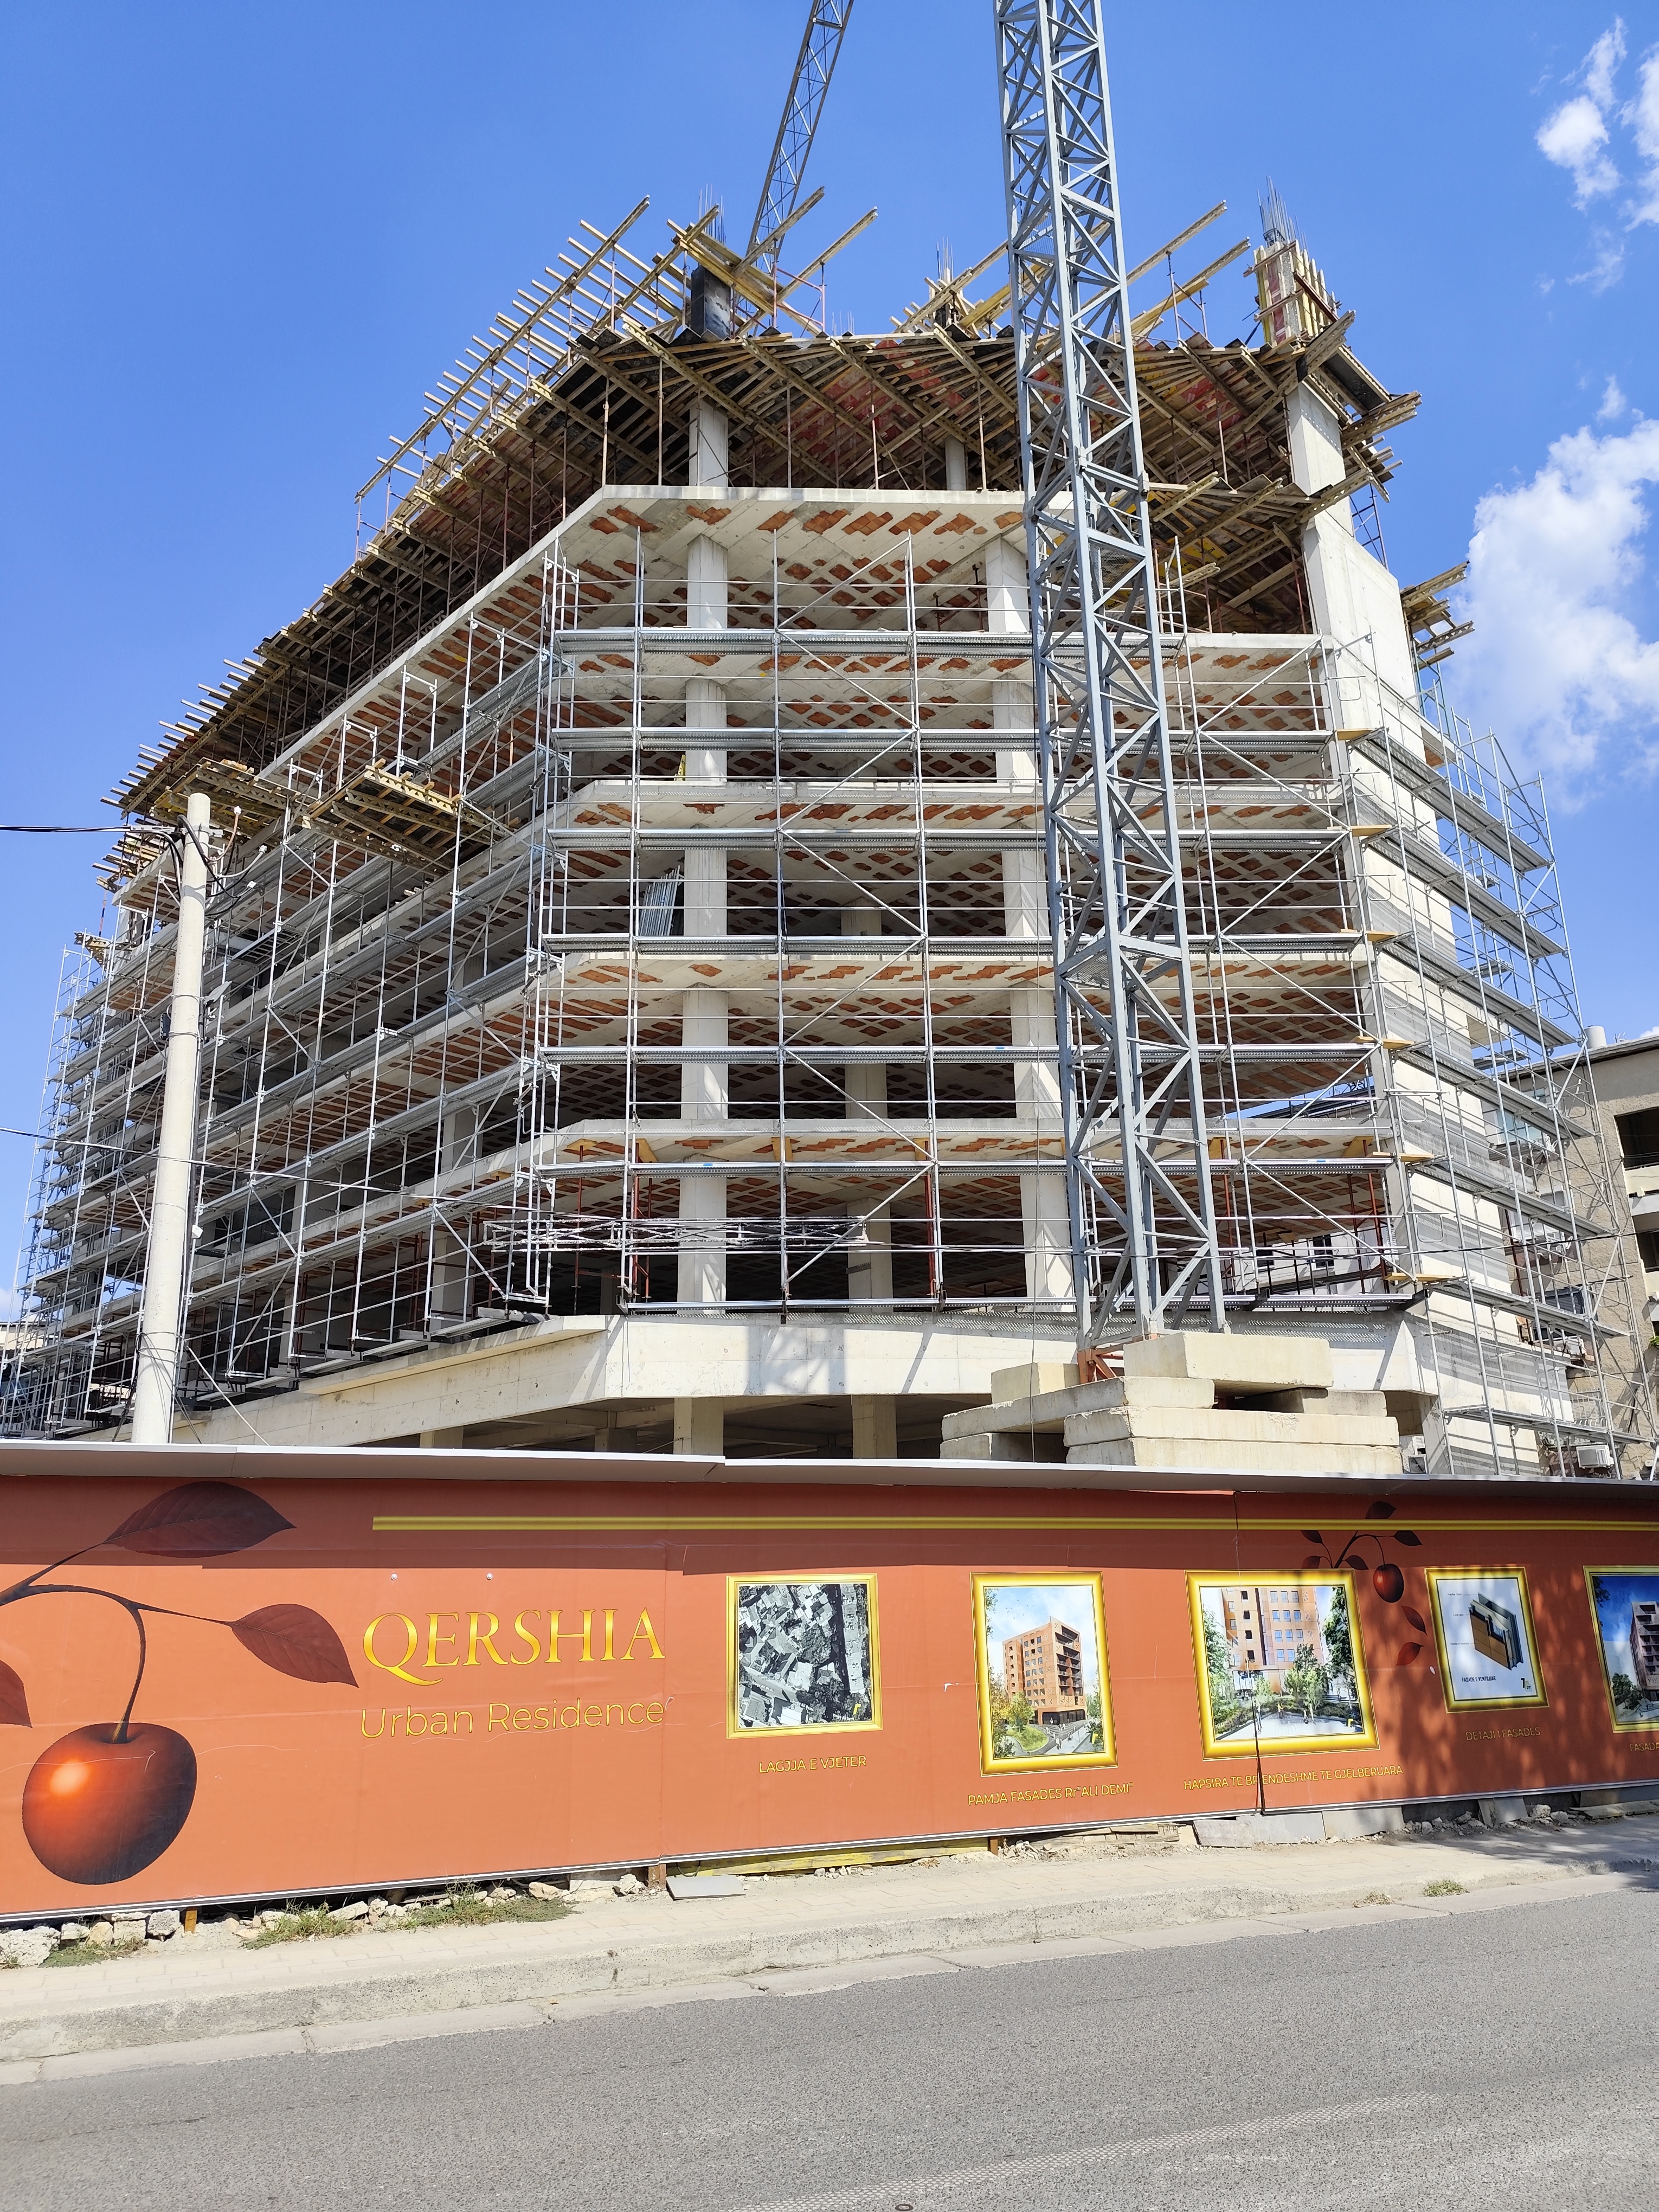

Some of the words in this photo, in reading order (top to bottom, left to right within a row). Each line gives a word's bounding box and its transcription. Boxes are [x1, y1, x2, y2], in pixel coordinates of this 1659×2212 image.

[363, 1607, 665, 1686] QERSHIA
[361, 1705, 473, 1738] Urban
[488, 1697, 664, 1732] Residence
[1465, 1730, 1496, 1740] DETAJI
[1502, 1727, 1541, 1738] FASADES
[759, 1759, 806, 1773] LAGJJA
[809, 1758, 818, 1770] E
[820, 1755, 867, 1769] VJETER
[1184, 1778, 1230, 1790] HAPSIRA
[1230, 1776, 1243, 1787] TE
[1321, 1771, 1333, 1780] TE
[1334, 1765, 1404, 1779] GJELBERUARA
[968, 1792, 1008, 1806] PAMJA
[1010, 1788, 1063, 1803] FASADES
